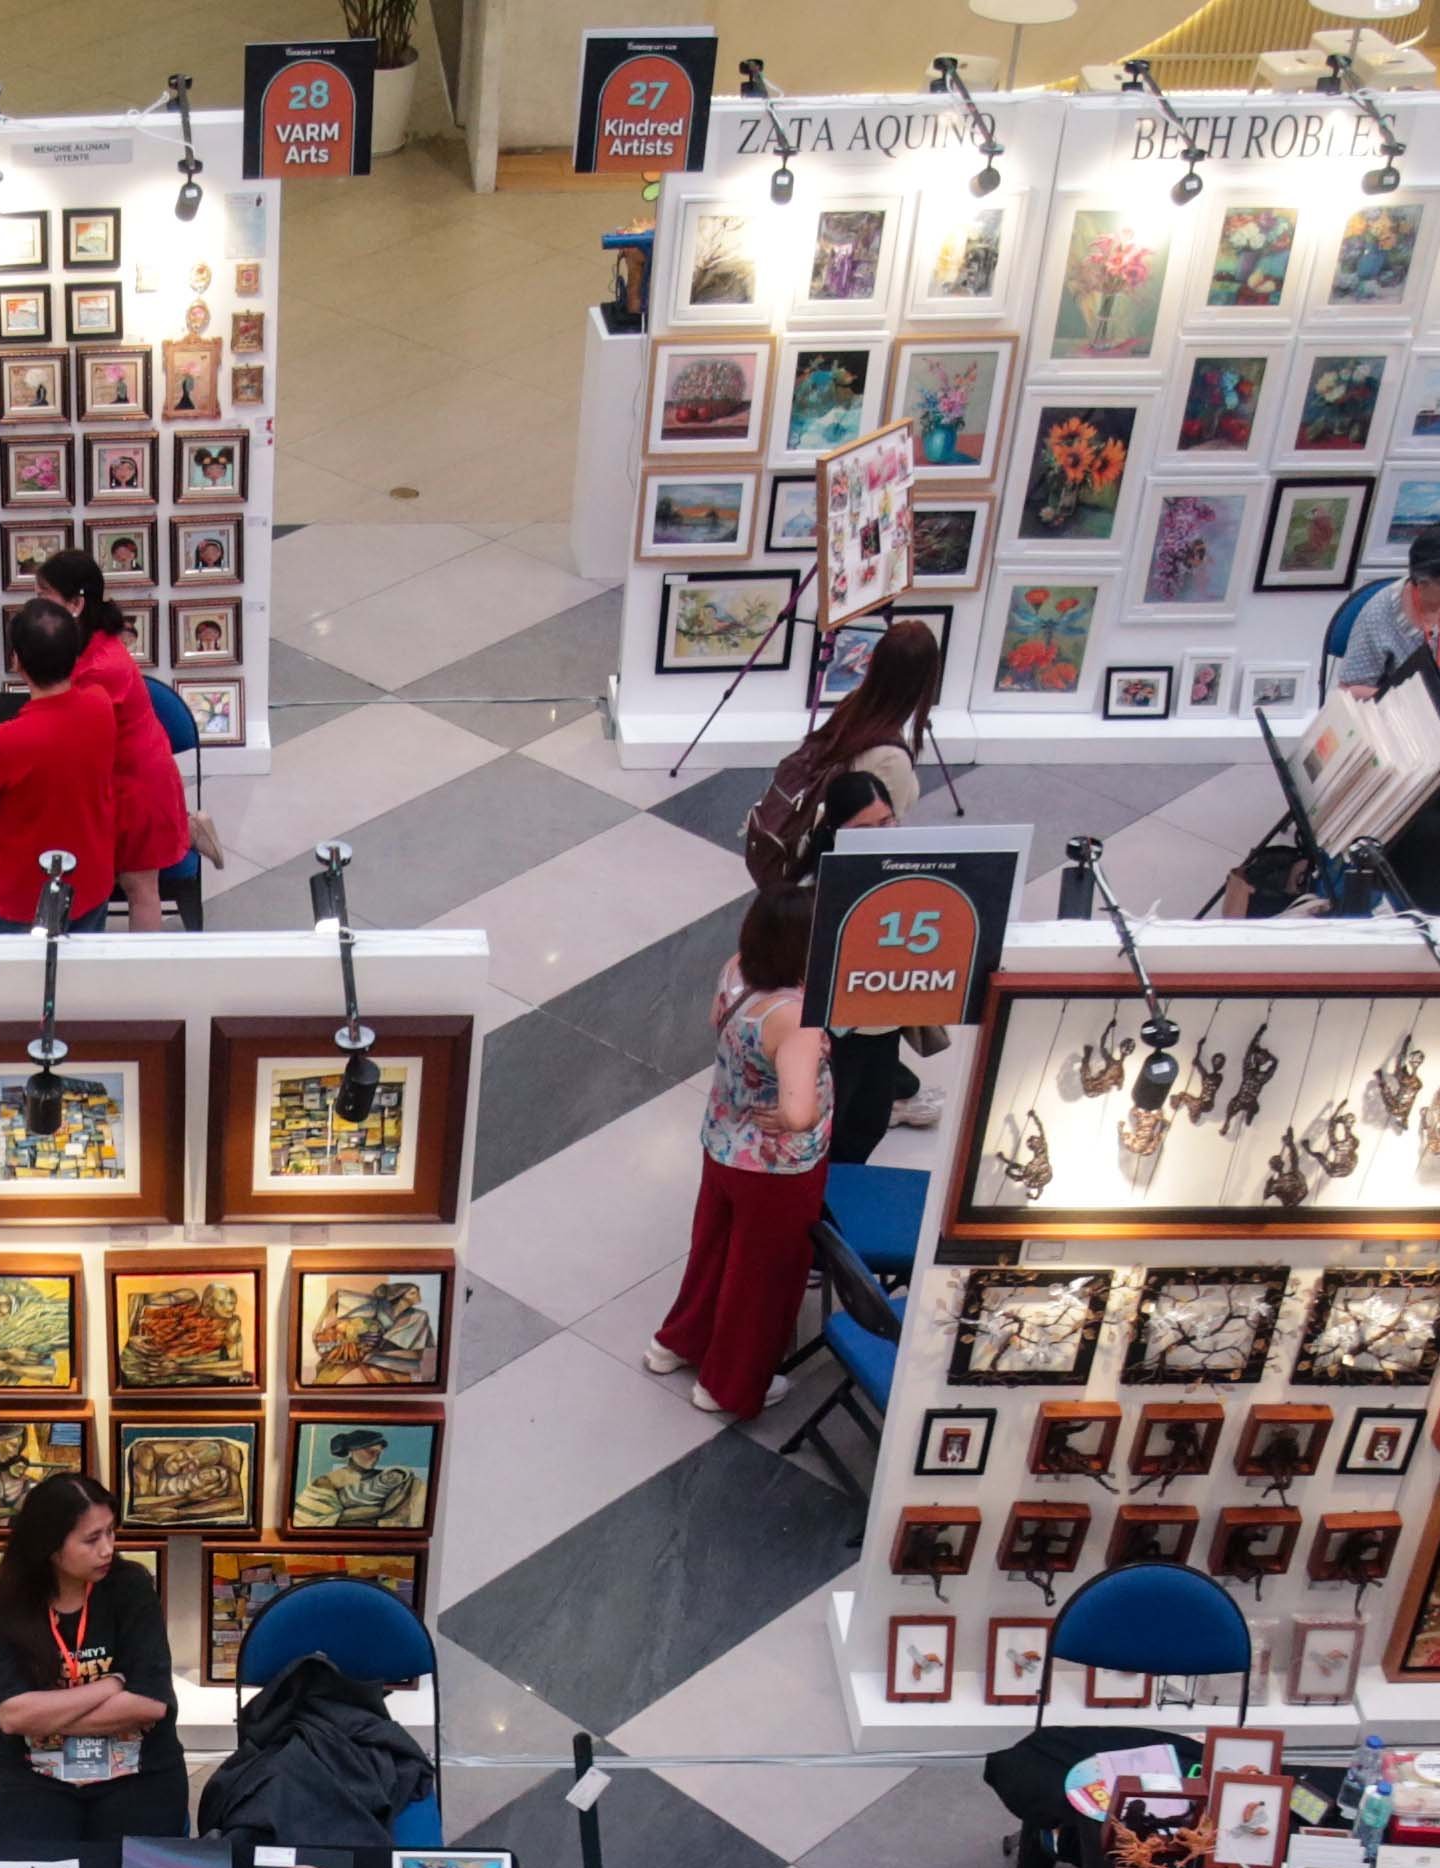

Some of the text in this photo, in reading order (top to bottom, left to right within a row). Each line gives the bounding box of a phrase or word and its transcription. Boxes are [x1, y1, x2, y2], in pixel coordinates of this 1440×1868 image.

[288, 80, 330, 110] 28
[627, 80, 669, 110] 27
[276, 122, 340, 144] VARM
[604, 118, 684, 136] Kindred
[737, 112, 996, 157] ZATA AQUINO
[1132, 115, 1236, 160] BETH
[284, 144, 329, 165] Arts
[609, 138, 673, 156] Artists
[877, 911, 942, 955] 15
[847, 970, 957, 993] FOURM
[76, 1737, 105, 1747] your
[77, 1745, 103, 1758] art
